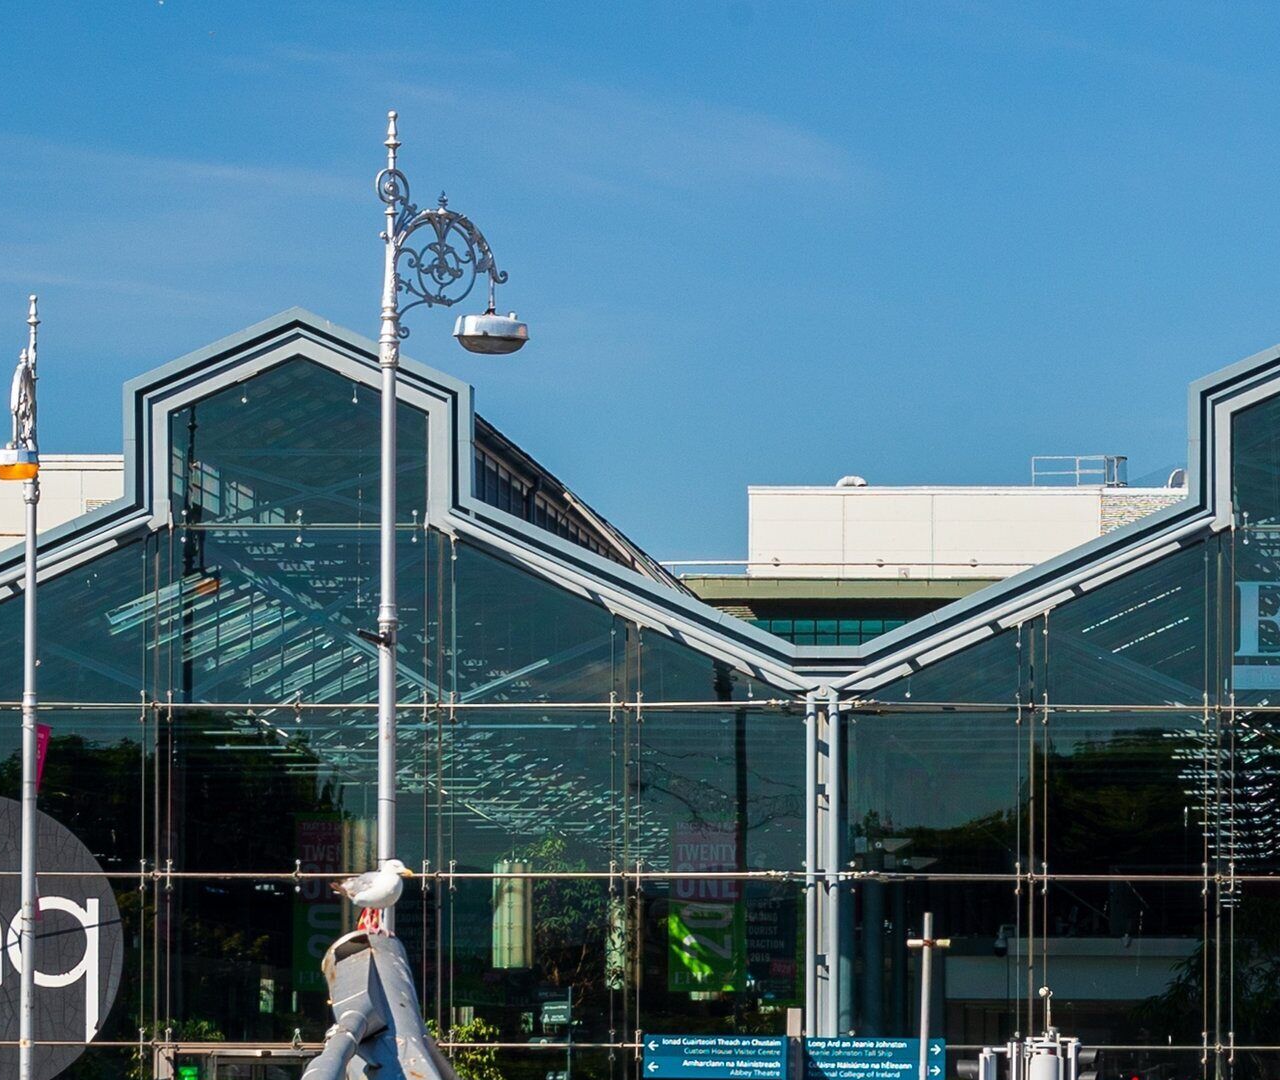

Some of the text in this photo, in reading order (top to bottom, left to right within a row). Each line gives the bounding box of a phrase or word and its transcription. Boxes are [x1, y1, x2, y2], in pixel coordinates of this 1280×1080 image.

[676, 863, 739, 898] ONE
[662, 1038, 681, 1046] Ionad
[717, 1038, 740, 1046] Theach
[751, 1038, 782, 1047] Chustaim
[807, 1040, 826, 1049] Long
[827, 1040, 840, 1048] Ard
[757, 1048, 781, 1056] Centre
[808, 1049, 830, 1057] Jeanie
[877, 1050, 893, 1058] Ship
[682, 1059, 725, 1068] Amharclann
[730, 1069, 781, 1077] Abbey Theatre
[838, 1071, 865, 1079] College
